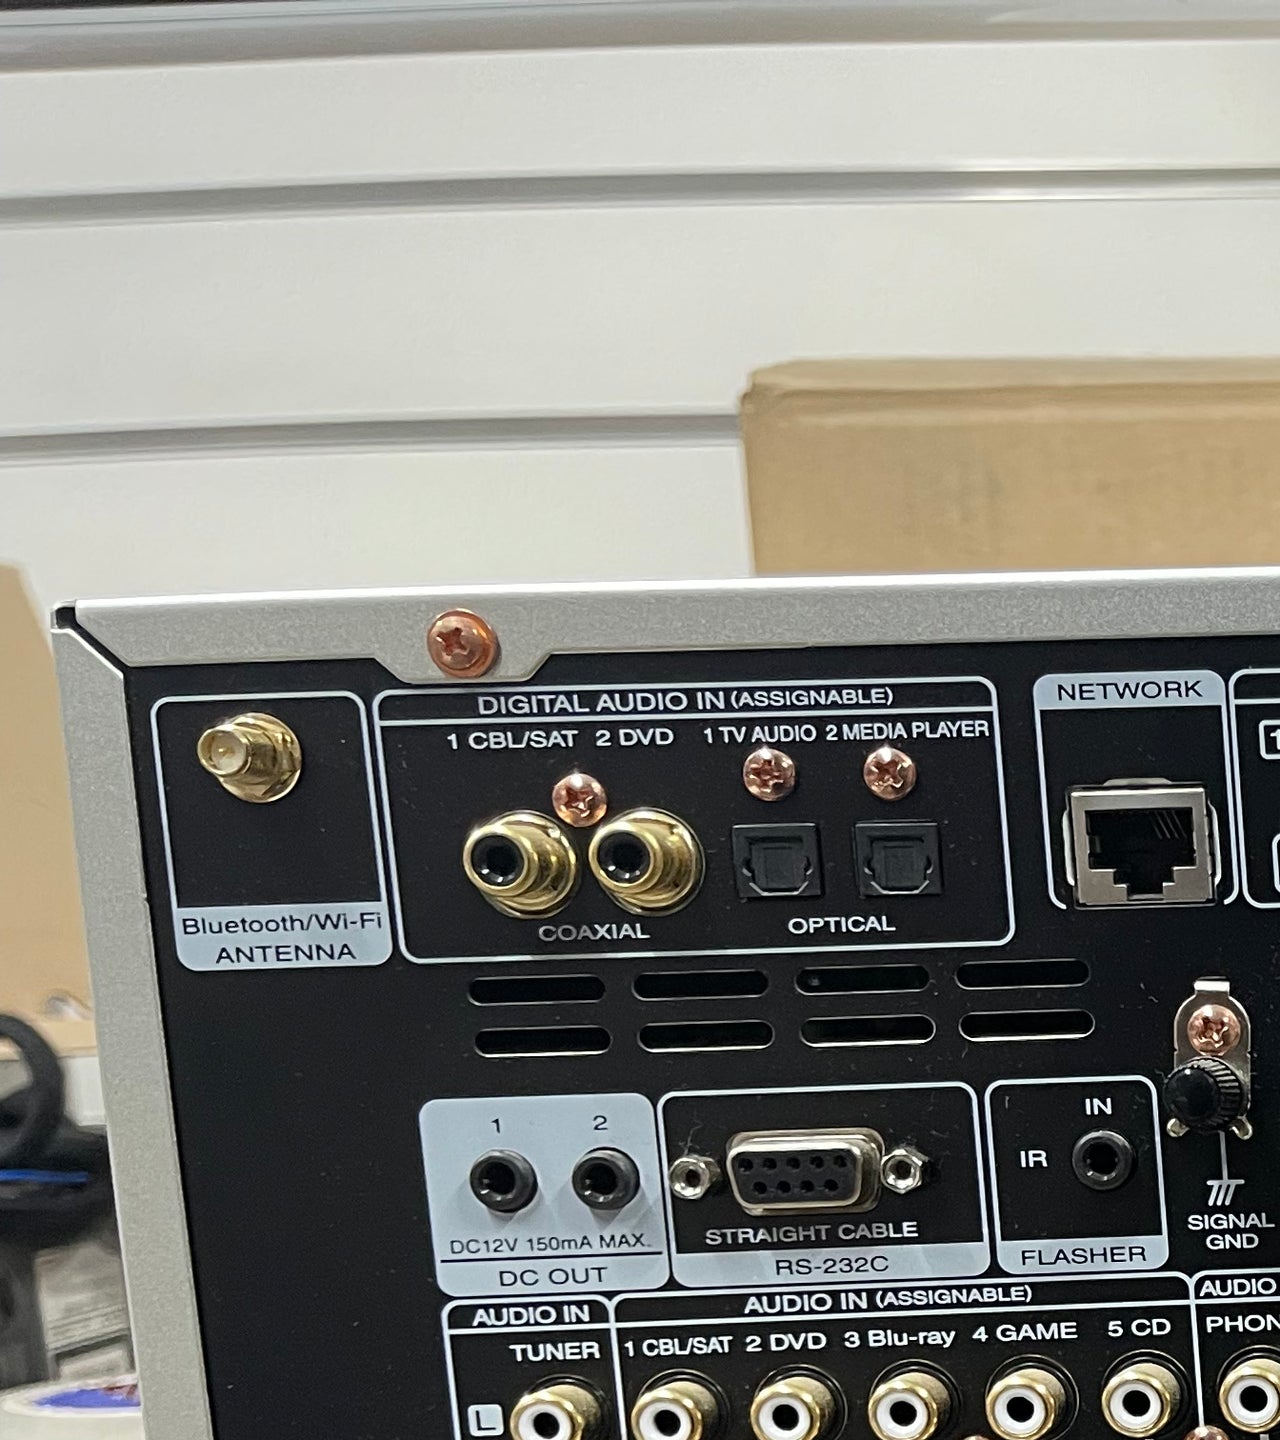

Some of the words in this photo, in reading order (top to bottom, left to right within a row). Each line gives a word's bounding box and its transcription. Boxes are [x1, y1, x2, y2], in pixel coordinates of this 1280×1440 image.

[1057, 680, 1203, 701] NETWORK
[478, 694, 590, 715] DIGITAL
[597, 690, 688, 713] AUDIO
[697, 690, 725, 710] IN
[730, 687, 893, 710] (ASSIGNABLE)
[704, 727, 715, 743] 1
[718, 726, 747, 744] TV
[751, 724, 817, 743] AUDIO
[826, 724, 838, 741] 2
[842, 722, 907, 740] MEDIA
[913, 720, 989, 739] PLAYER
[182, 910, 383, 935] Bluetooth/Wi-Fi
[539, 922, 649, 942] COAXIAL
[788, 916, 896, 935] OPTICAL
[216, 943, 356, 963] ANTENNA
[1020, 1150, 1048, 1167] IR
[1188, 1213, 1275, 1230] SIGNAL
[705, 1225, 831, 1246] STRAIGHT
[838, 1222, 919, 1240] CABLE
[1206, 1234, 1259, 1250] GND
[450, 1237, 518, 1255] DC12V
[527, 1235, 593, 1252] 150mA
[1021, 1246, 1146, 1265] FLASHER
[776, 1256, 889, 1276] RS-232C
[744, 1295, 831, 1315] AUDIO
[838, 1294, 867, 1310] IN
[875, 1284, 1032, 1309] (ASSIGNABLE)
[509, 1341, 600, 1362] TUNER
